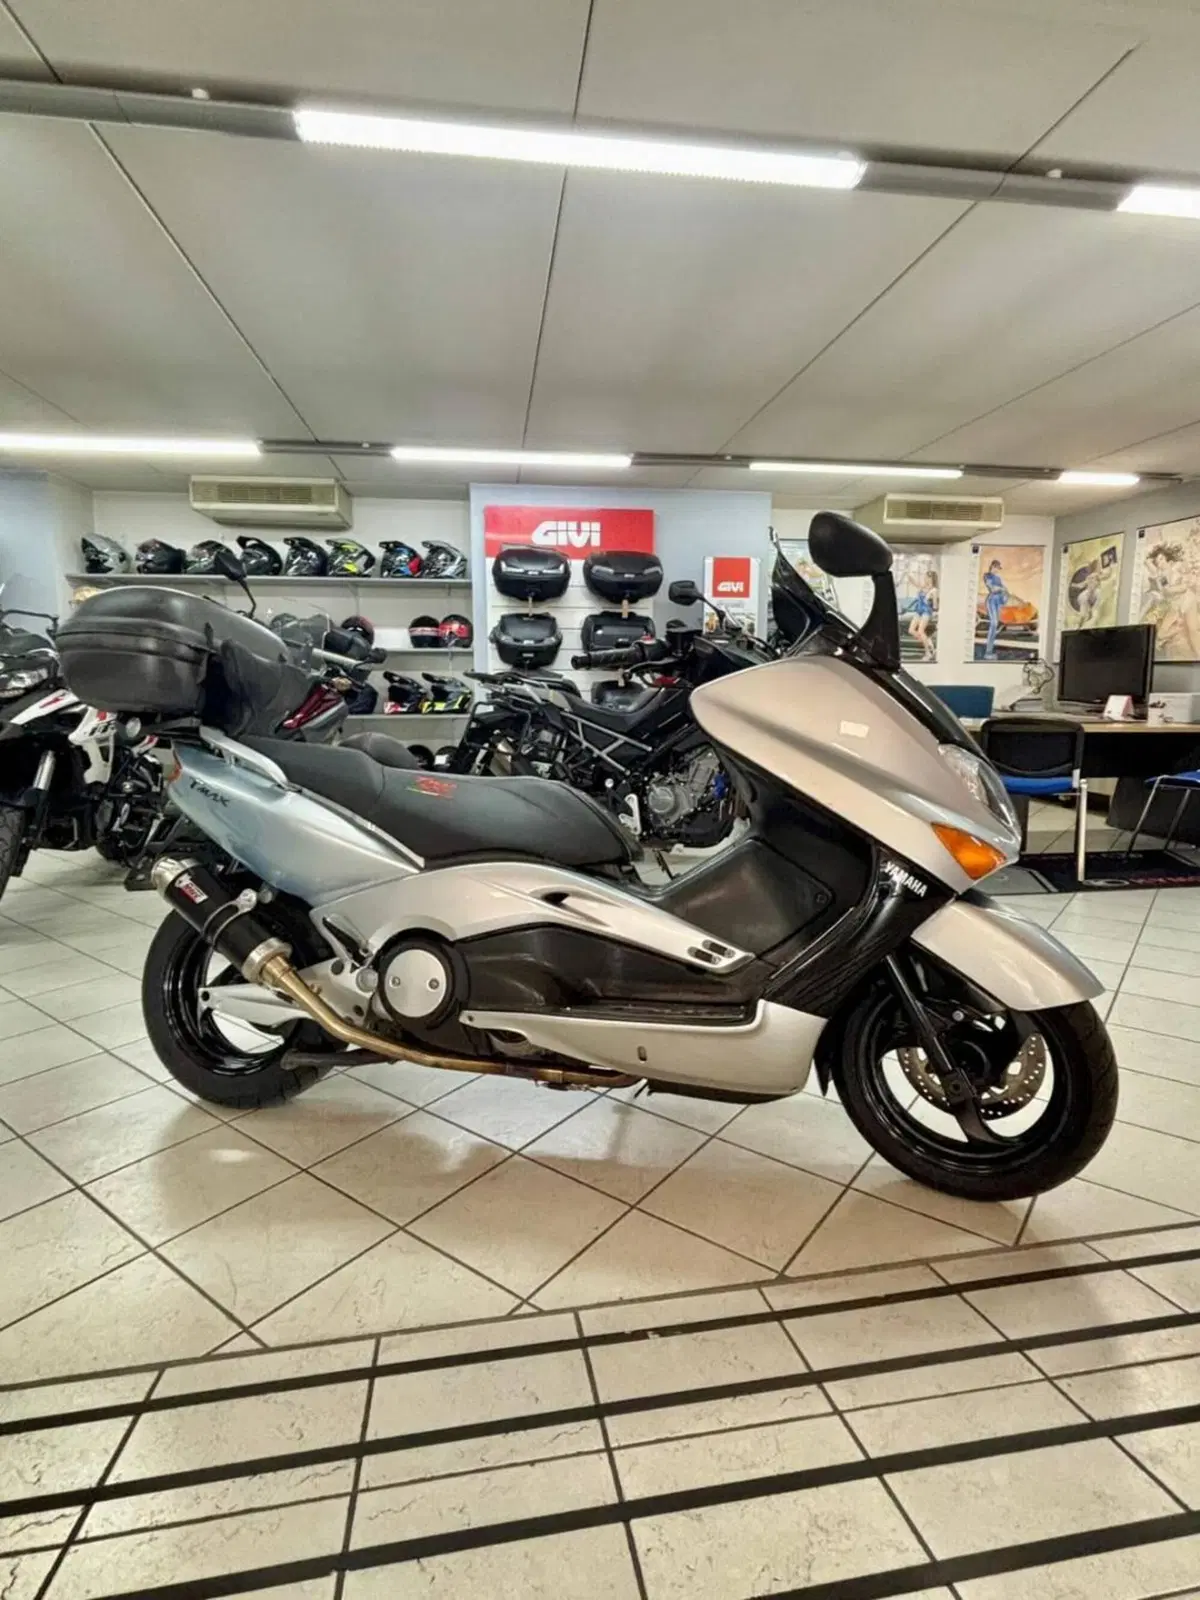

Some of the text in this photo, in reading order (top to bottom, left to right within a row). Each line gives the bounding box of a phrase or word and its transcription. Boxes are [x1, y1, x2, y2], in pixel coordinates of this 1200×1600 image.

[532, 520, 601, 548] GIVI
[717, 581, 744, 593] GIVI
[884, 861, 928, 898] YAMAHA
